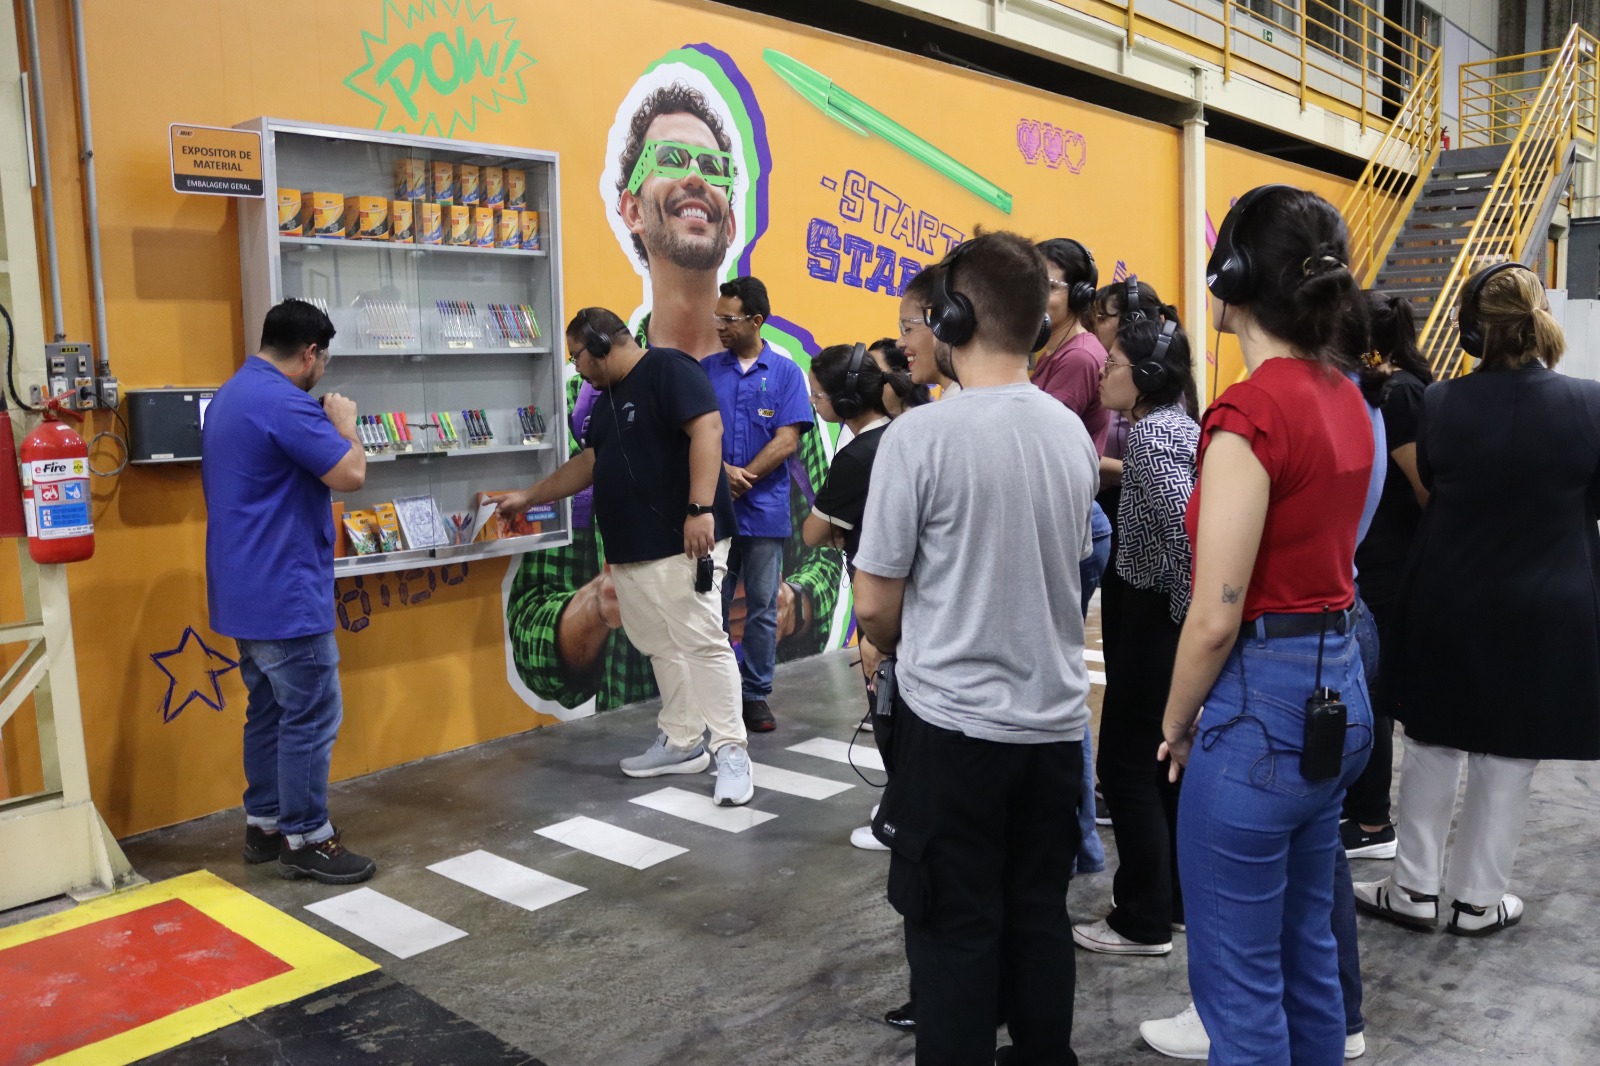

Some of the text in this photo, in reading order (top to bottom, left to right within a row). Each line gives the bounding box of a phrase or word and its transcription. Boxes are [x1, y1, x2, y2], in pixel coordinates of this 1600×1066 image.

[374, 26, 522, 122] POW!
[182, 145, 252, 160] EXPOSITOR DE
[193, 159, 243, 172] MATERIAL
[187, 179, 251, 191] EMBALAGEM GERAL
